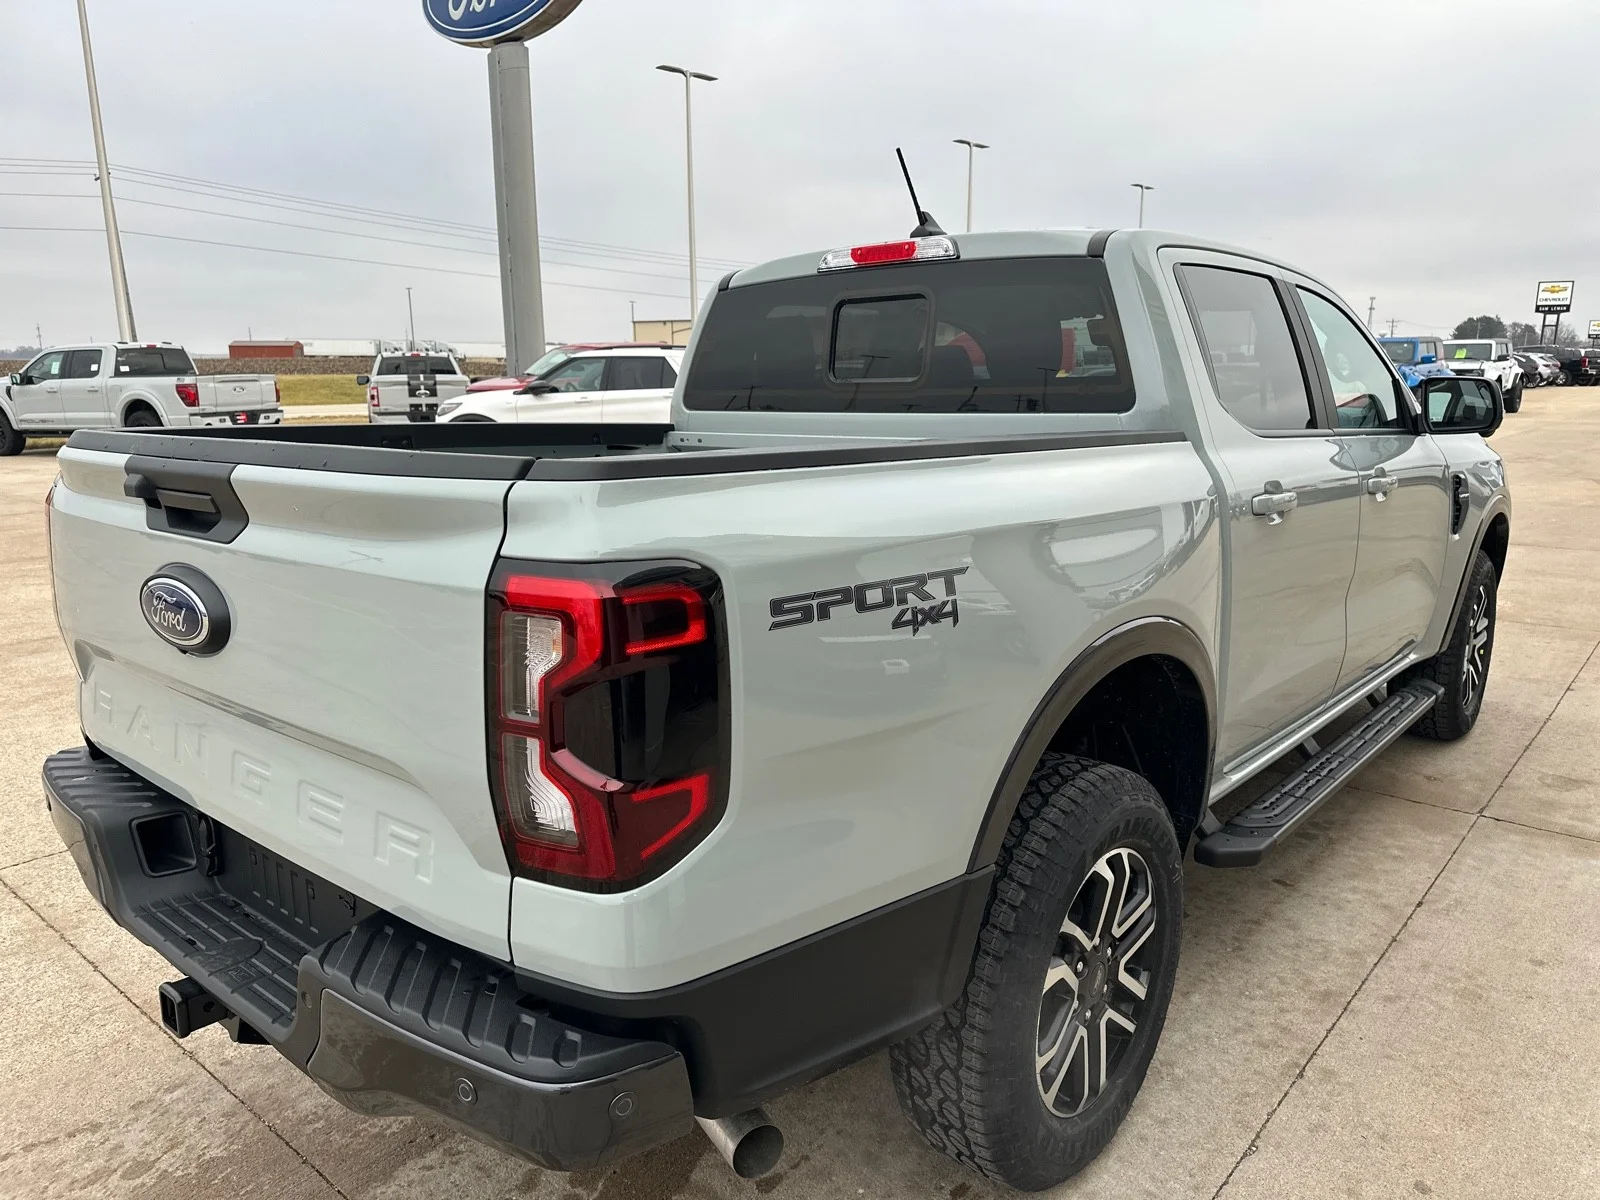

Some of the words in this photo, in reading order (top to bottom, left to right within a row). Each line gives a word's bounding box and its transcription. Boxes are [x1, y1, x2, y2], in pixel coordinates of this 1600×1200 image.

[151, 591, 187, 632] Ford
[768, 565, 970, 631] SPORT
[93, 680, 434, 885] RANGER
